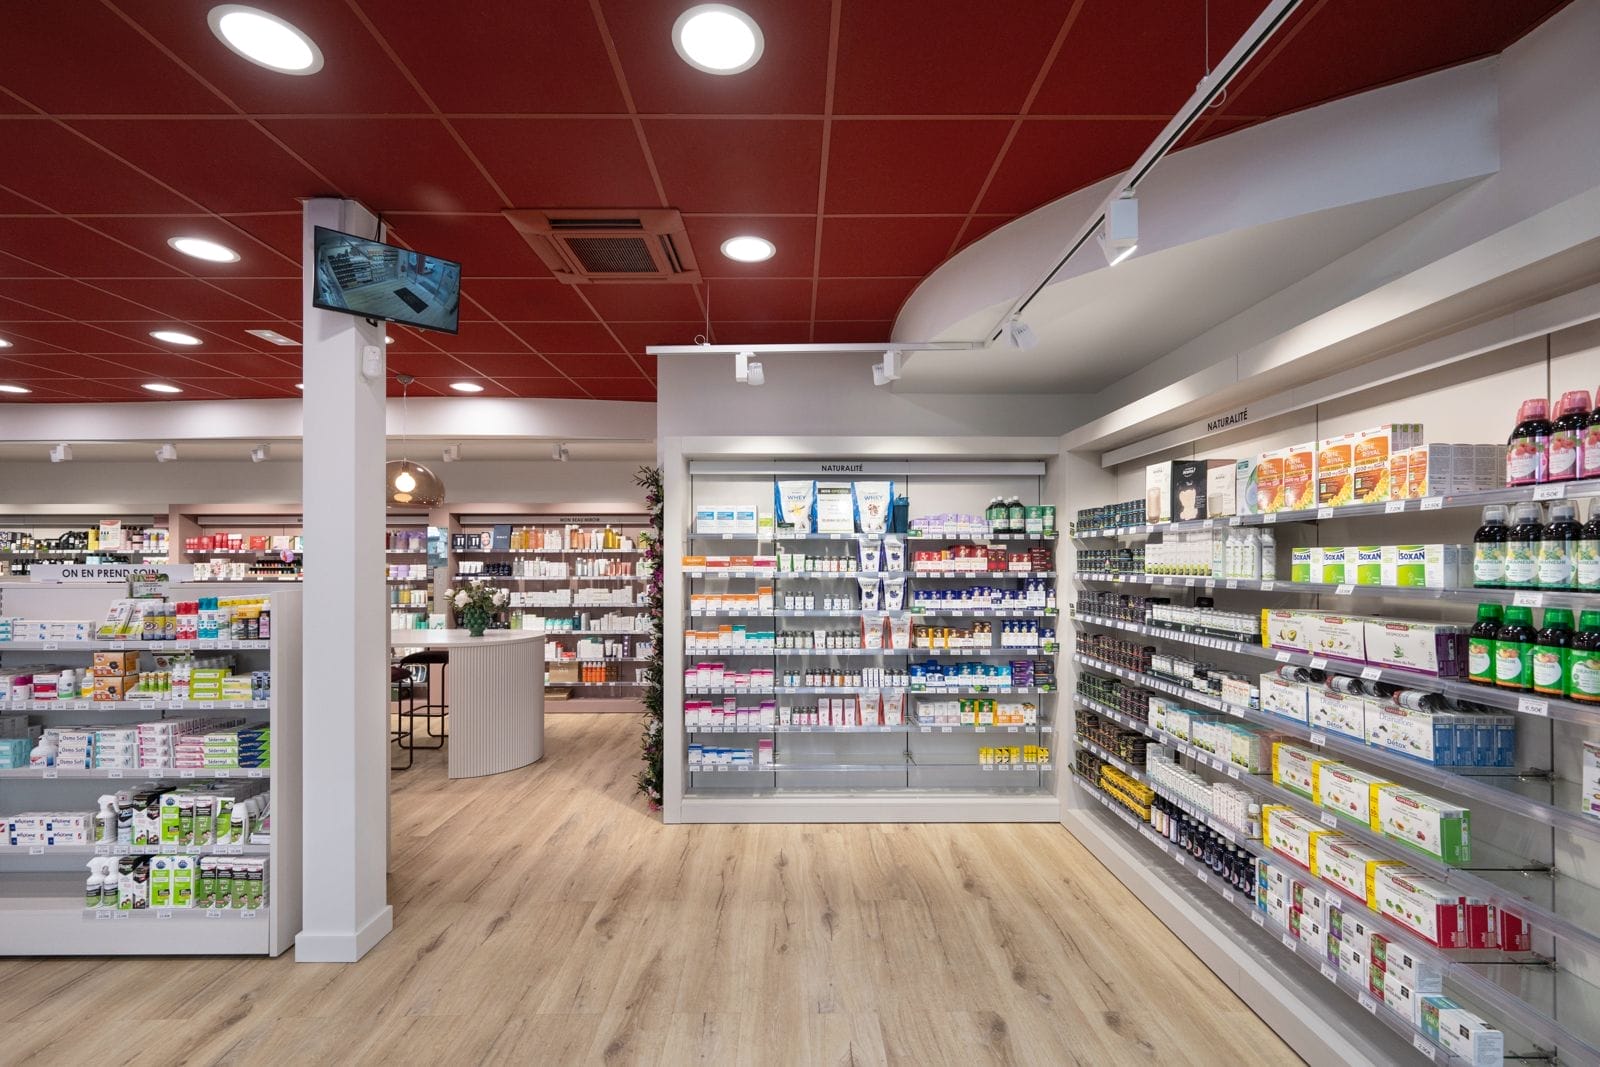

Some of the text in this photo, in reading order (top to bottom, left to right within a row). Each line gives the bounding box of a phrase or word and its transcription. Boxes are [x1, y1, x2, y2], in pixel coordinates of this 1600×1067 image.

[1207, 408, 1248, 432] NATURALITÉ
[821, 464, 863, 472] NATURALITÉ
[1294, 552, 1310, 560] ISOXAN
[1324, 552, 1344, 560] ISOXAN
[1358, 551, 1381, 560] ISOXAN
[1398, 550, 1424, 560] ISOXAN
[62, 569, 78, 578] ON
[82, 569, 94, 578] EN
[98, 569, 130, 578] PREND
[1386, 738, 1407, 749] Détox
